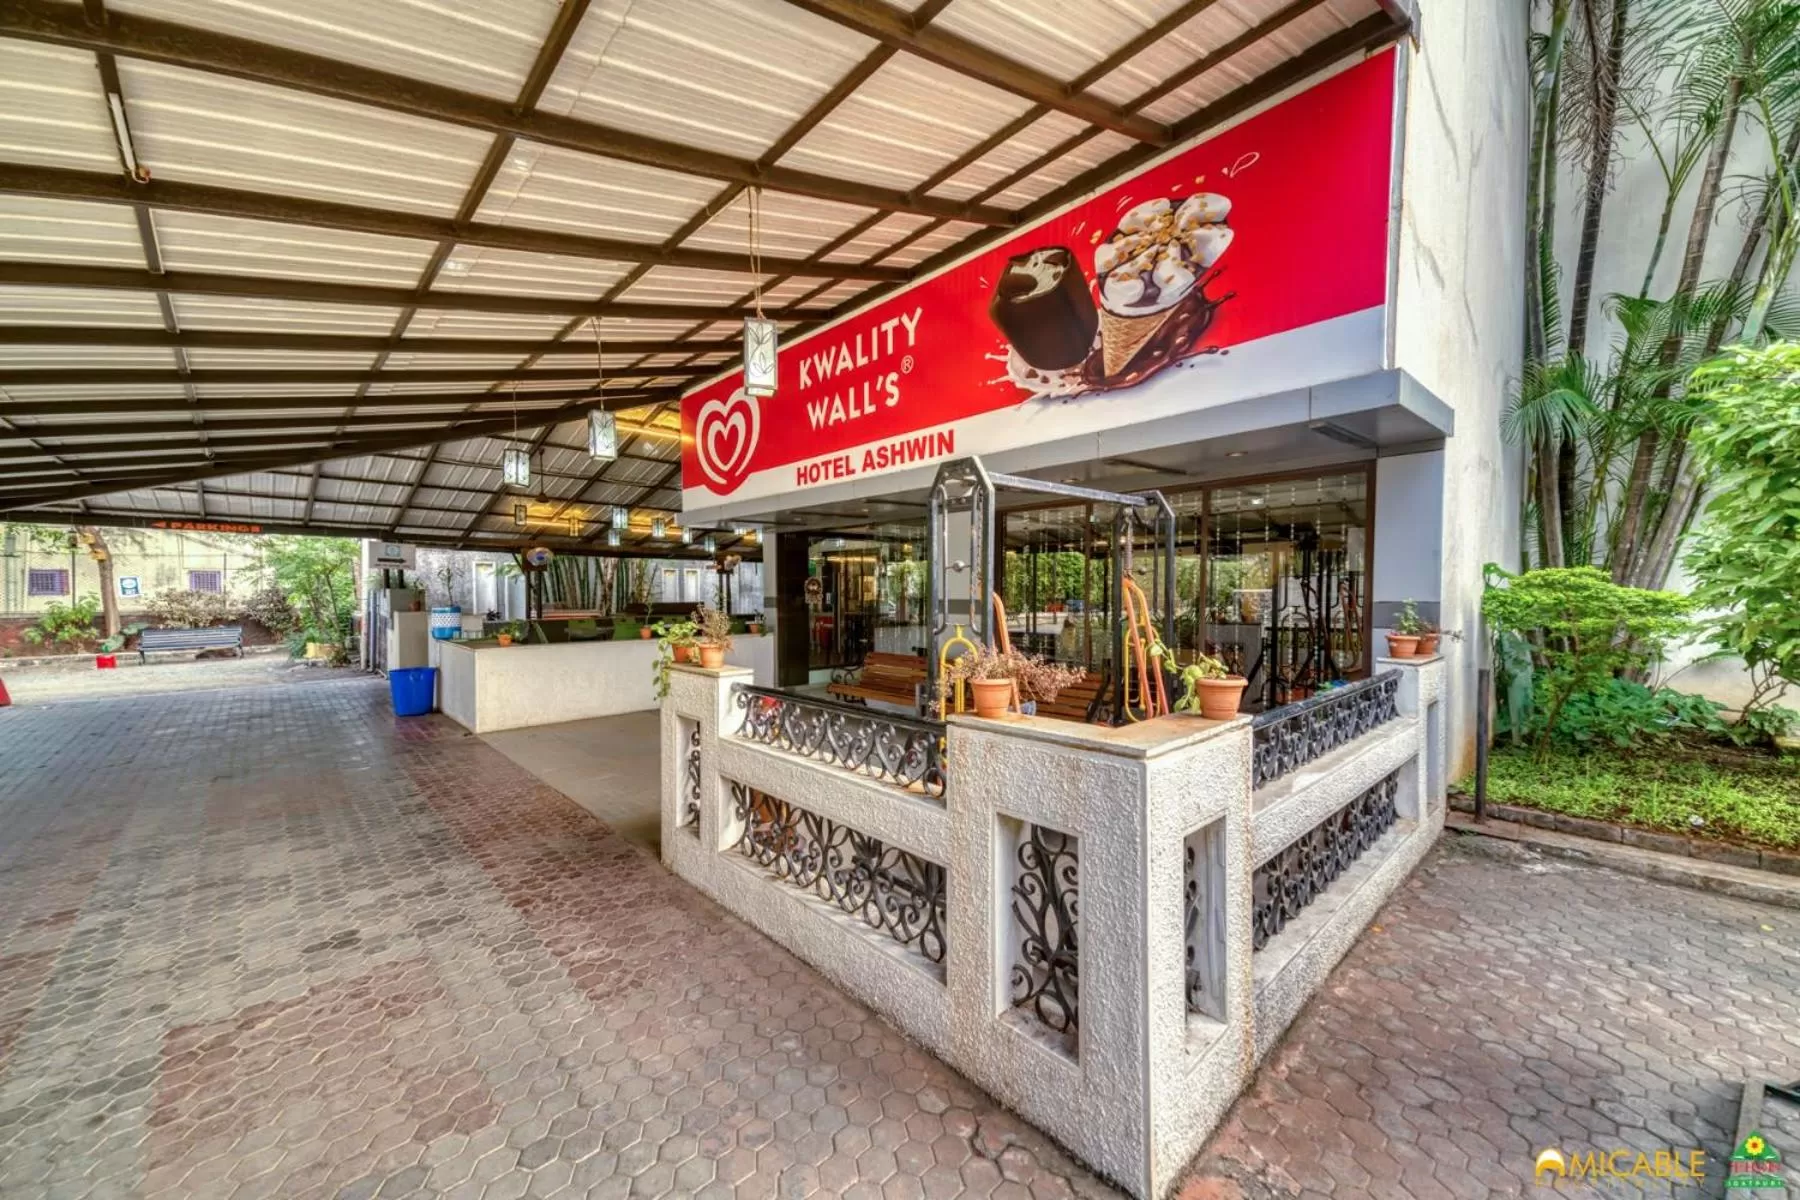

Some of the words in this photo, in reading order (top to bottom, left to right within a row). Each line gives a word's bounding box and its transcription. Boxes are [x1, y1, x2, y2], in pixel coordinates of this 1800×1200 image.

[799, 307, 923, 390] KWALITY
[796, 455, 856, 486] HOTEL
[862, 429, 955, 473] ASHWIN
